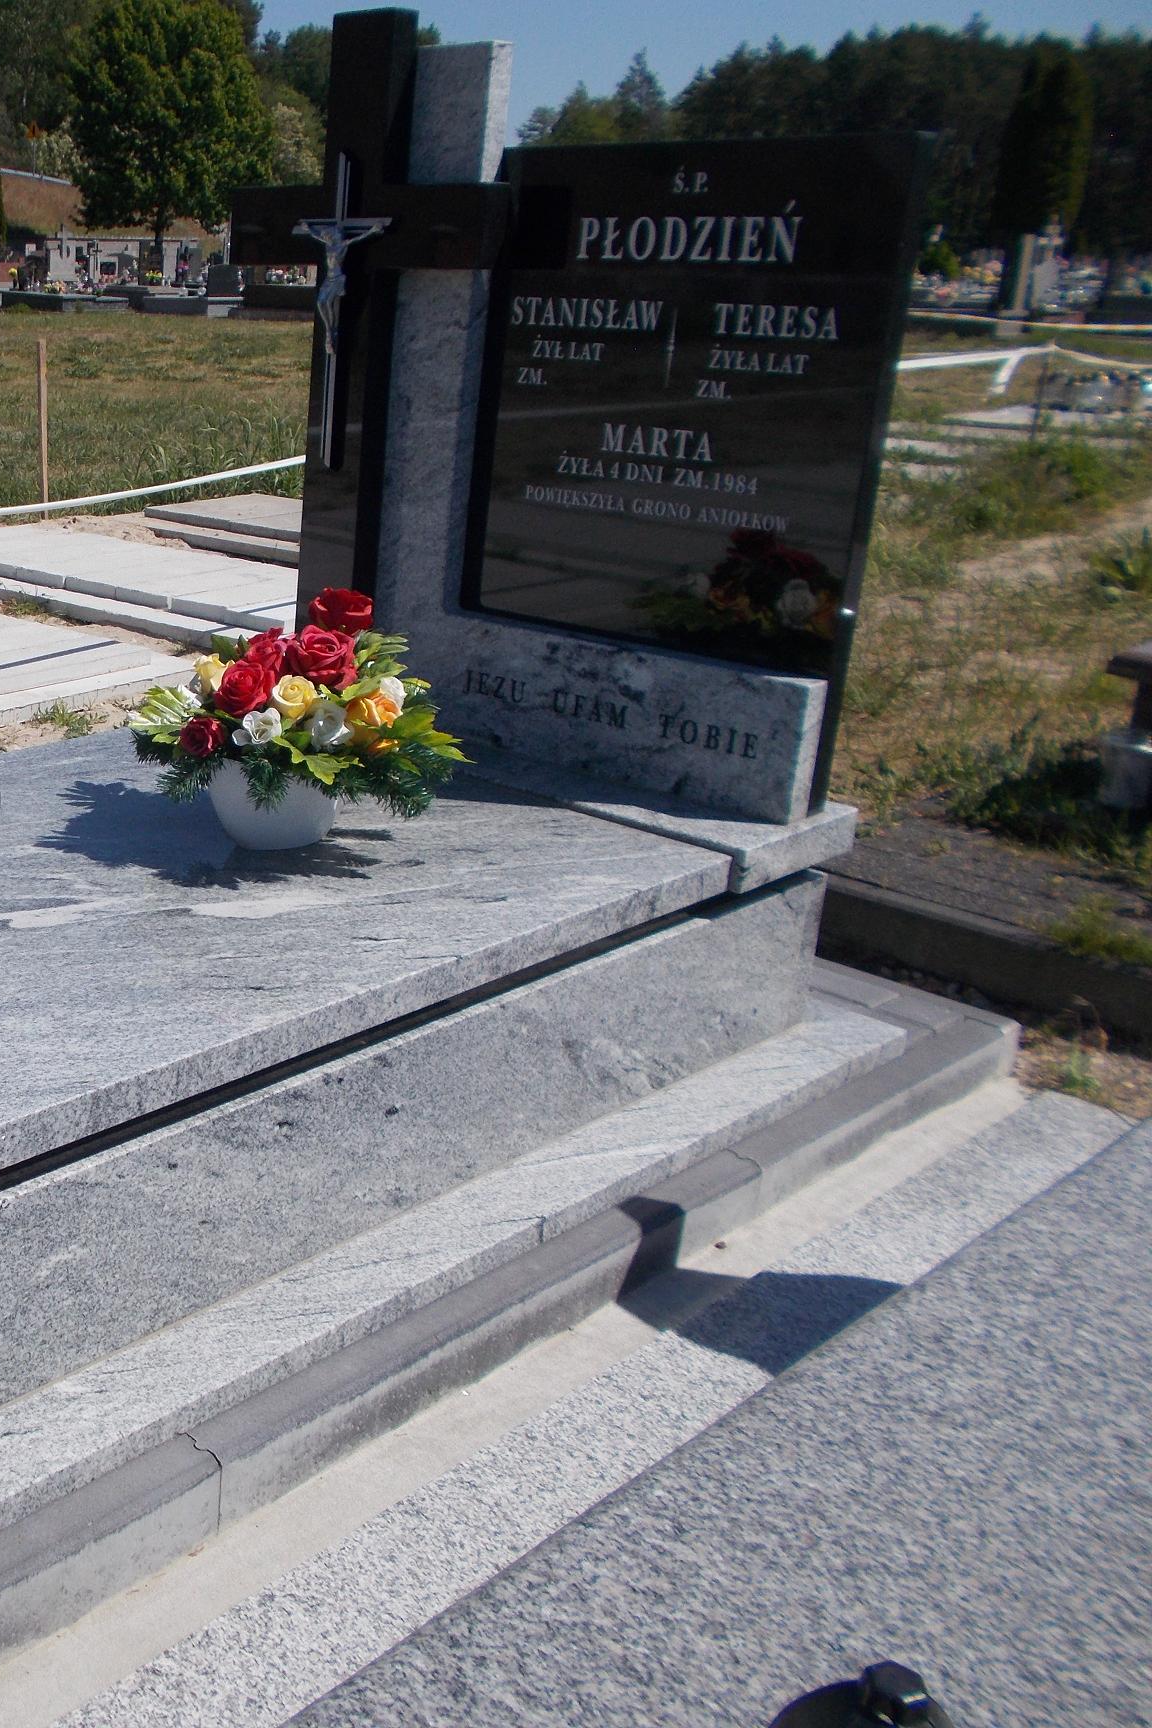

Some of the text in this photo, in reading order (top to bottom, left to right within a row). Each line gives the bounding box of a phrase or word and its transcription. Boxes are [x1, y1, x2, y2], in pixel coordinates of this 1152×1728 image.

[576, 200, 803, 263] PŁODZIEŃ
[510, 296, 664, 332] STANISŁAW
[713, 303, 840, 340] TERESA
[532, 334, 605, 362] ŻYŁ LAT
[708, 344, 810, 375] ŻYŁA LAT
[517, 367, 548, 386] ZM.
[696, 379, 732, 400] ZM.
[600, 422, 713, 462] MARTA
[610, 462, 620, 479] 4
[625, 463, 664, 484] DNI
[631, 498, 691, 521] GRONO
[462, 669, 759, 760] JEZU UFAM TOBIE
